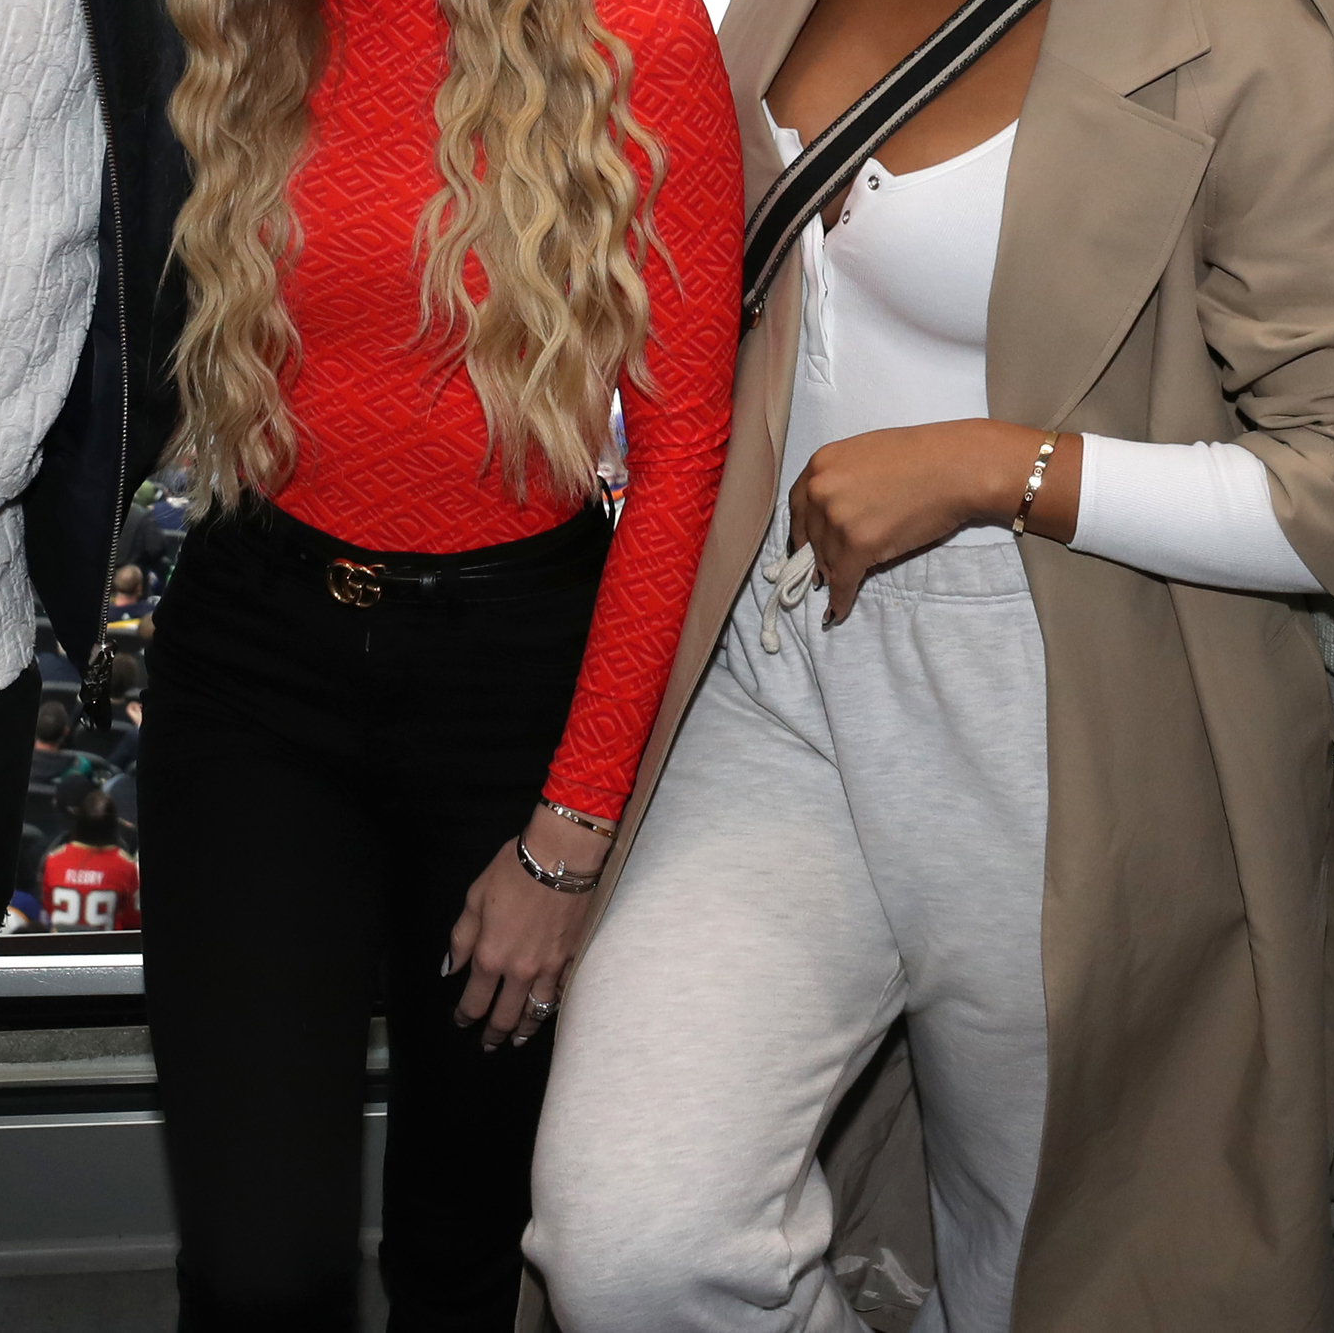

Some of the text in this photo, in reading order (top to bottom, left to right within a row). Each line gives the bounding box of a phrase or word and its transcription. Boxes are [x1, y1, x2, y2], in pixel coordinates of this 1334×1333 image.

[344, 435, 474, 503] FENDI
[64, 868, 105, 885] FLEURY
[51, 886, 118, 932] 29
